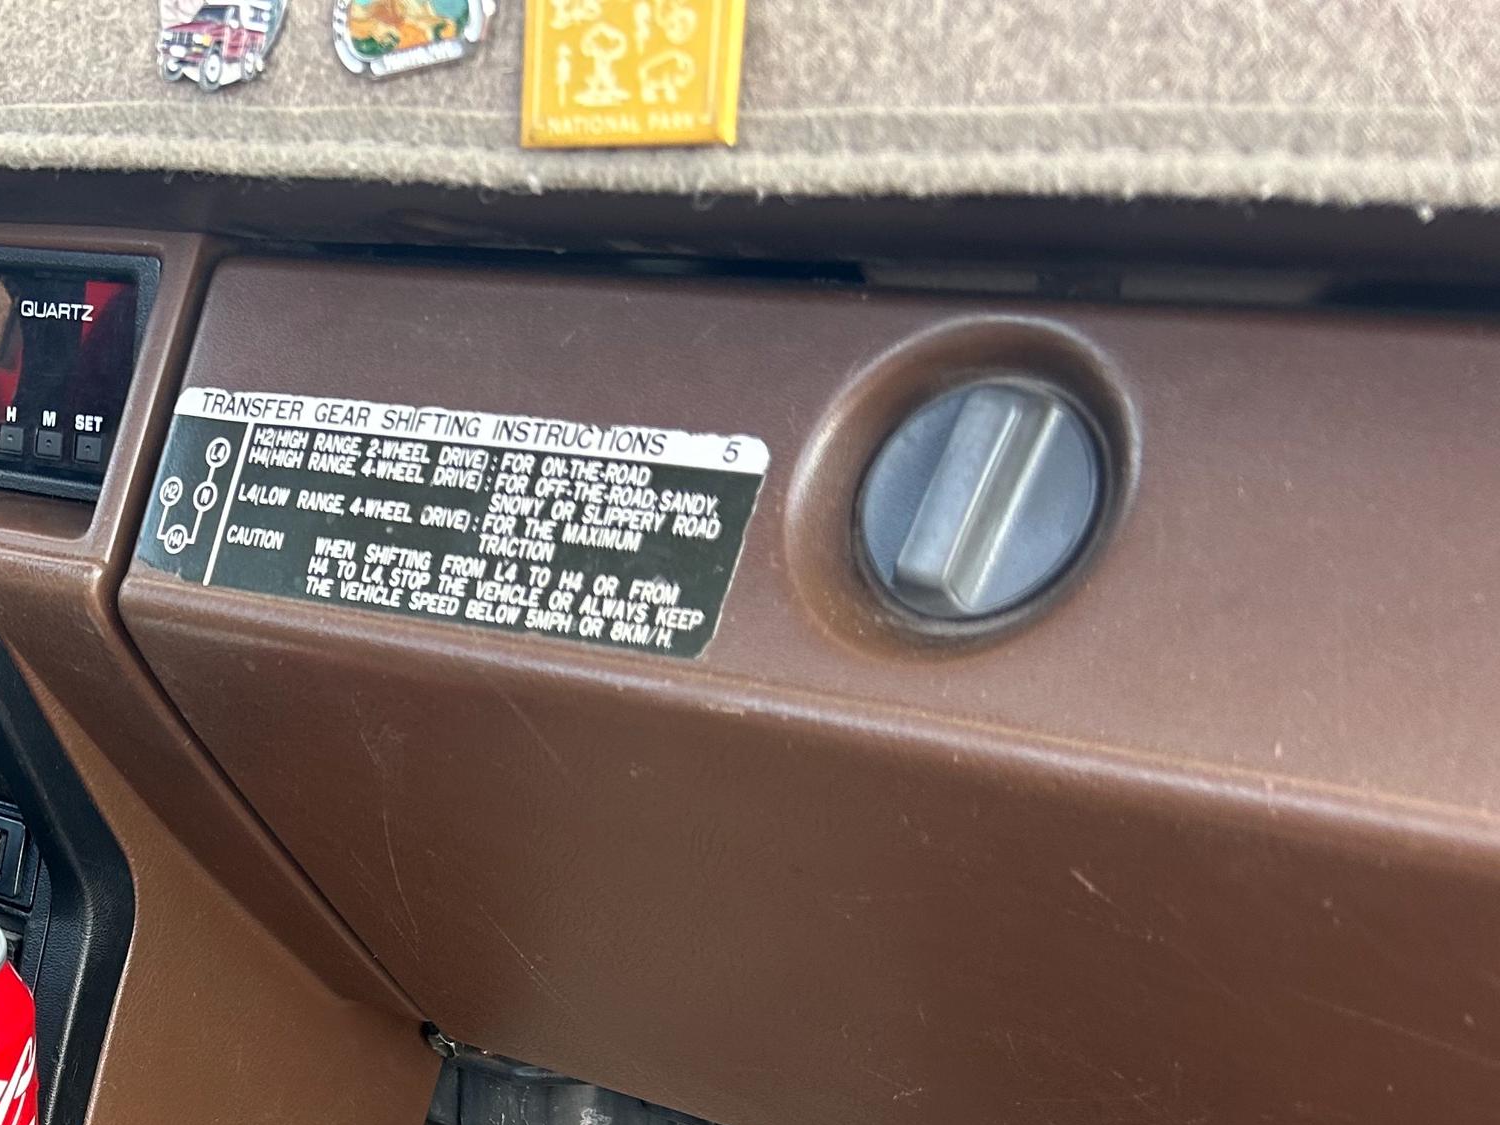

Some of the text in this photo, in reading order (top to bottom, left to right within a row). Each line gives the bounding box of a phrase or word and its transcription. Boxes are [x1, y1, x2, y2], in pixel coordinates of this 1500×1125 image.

[20, 300, 94, 322] QUARTZ
[6, 406, 17, 422] H
[42, 411, 56, 427] M
[75, 414, 103, 432] SET
[203, 392, 667, 456] TRANSFER GEAR SHIFTING INSTRUCTIONS
[308, 452, 356, 477] RANGE,
[360, 458, 424, 483] 4-WHEEL
[494, 472, 529, 496] FOR
[313, 432, 362, 457] RANGE,
[366, 439, 430, 464] 2-WHEEL
[500, 452, 535, 475] FOR
[541, 456, 652, 487] ON-THE-ROAD
[723, 441, 741, 463] 5
[226, 525, 284, 550] CAUTION
[296, 489, 345, 516] RANGE,
[350, 496, 413, 523] 4-WHEEL
[481, 513, 516, 536] FOR
[524, 518, 557, 540] THE
[562, 522, 643, 551] MAXIMUM
[488, 493, 722, 539] SNOWY OR SLIPPERY ROAD
[479, 533, 555, 562] TRACTION
[315, 536, 681, 606] WHEN SHIFTING FROM L4 TO H4 OR FROM
[306, 576, 334, 598] THE
[340, 581, 403, 608] VEHICLE
[408, 591, 460, 616] SPEED
[465, 599, 521, 625] BELOW
[524, 608, 573, 633] 5MPH
[578, 616, 605, 638] OR
[308, 556, 329, 576] H4
[337, 560, 356, 580] TO
[389, 567, 431, 590] STOP
[438, 574, 468, 597] THE
[476, 580, 543, 608] VEHICLE
[548, 590, 574, 613] OR
[579, 594, 650, 624] ALWAYS
[655, 607, 705, 631] KEEP
